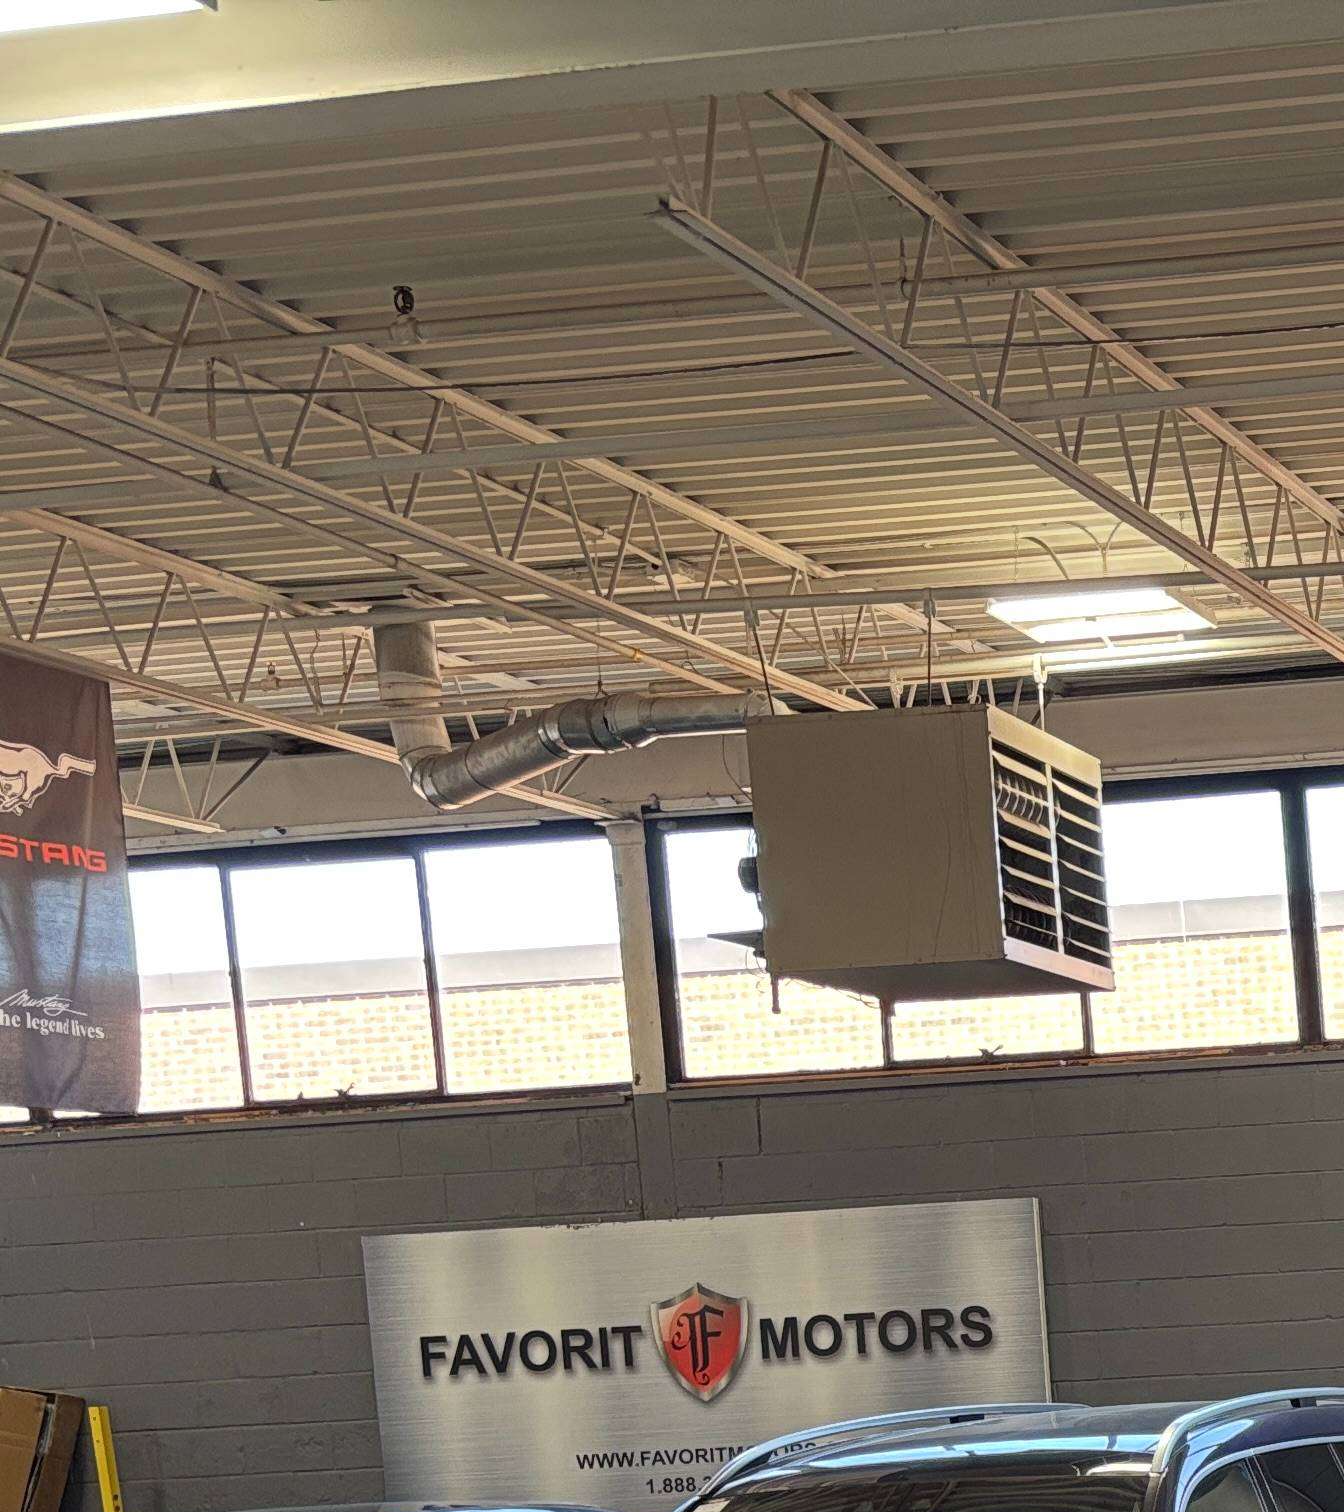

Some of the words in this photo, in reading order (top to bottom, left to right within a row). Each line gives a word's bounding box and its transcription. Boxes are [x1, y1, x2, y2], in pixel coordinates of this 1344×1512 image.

[0, 834, 107, 872] STANG
[0, 1008, 21, 1028] he
[26, 1011, 70, 1036] legend
[71, 1019, 105, 1039] lives
[419, 1325, 643, 1378] FAVORIT
[759, 1304, 994, 1360] MOTORS
